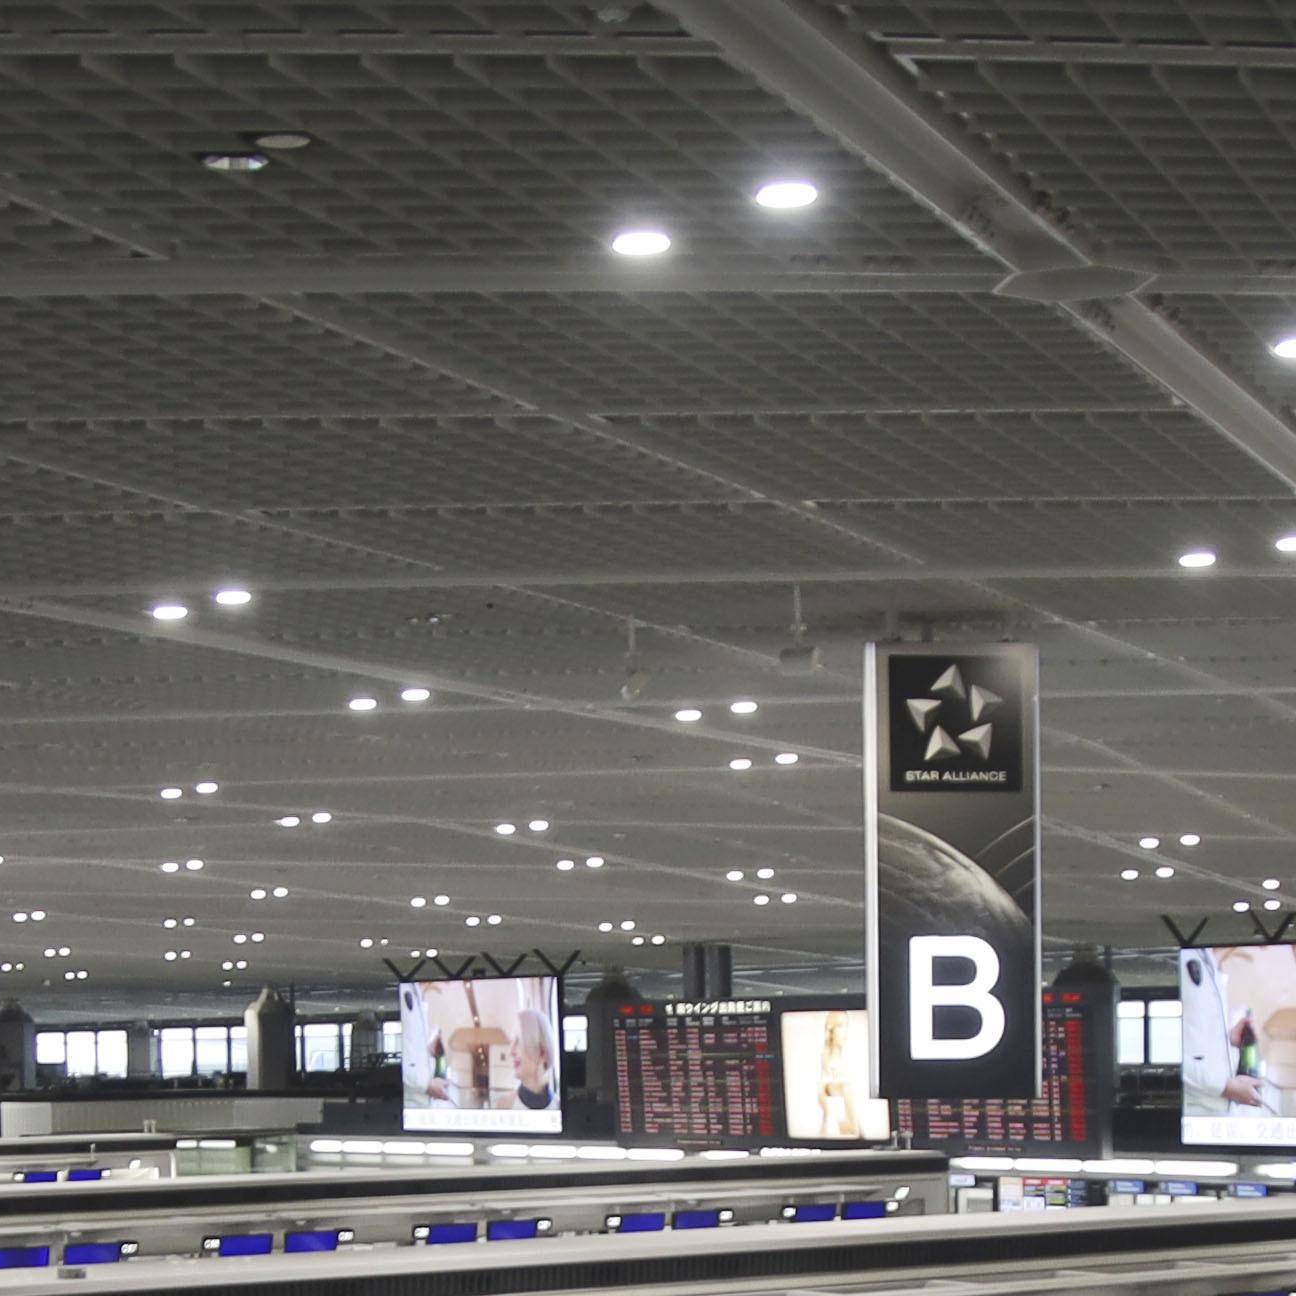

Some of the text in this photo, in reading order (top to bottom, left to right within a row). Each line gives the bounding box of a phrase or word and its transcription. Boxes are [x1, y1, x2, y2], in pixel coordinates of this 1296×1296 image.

[905, 770, 1007, 782] STAR ALLIANCE
[909, 934, 1006, 1061] B
